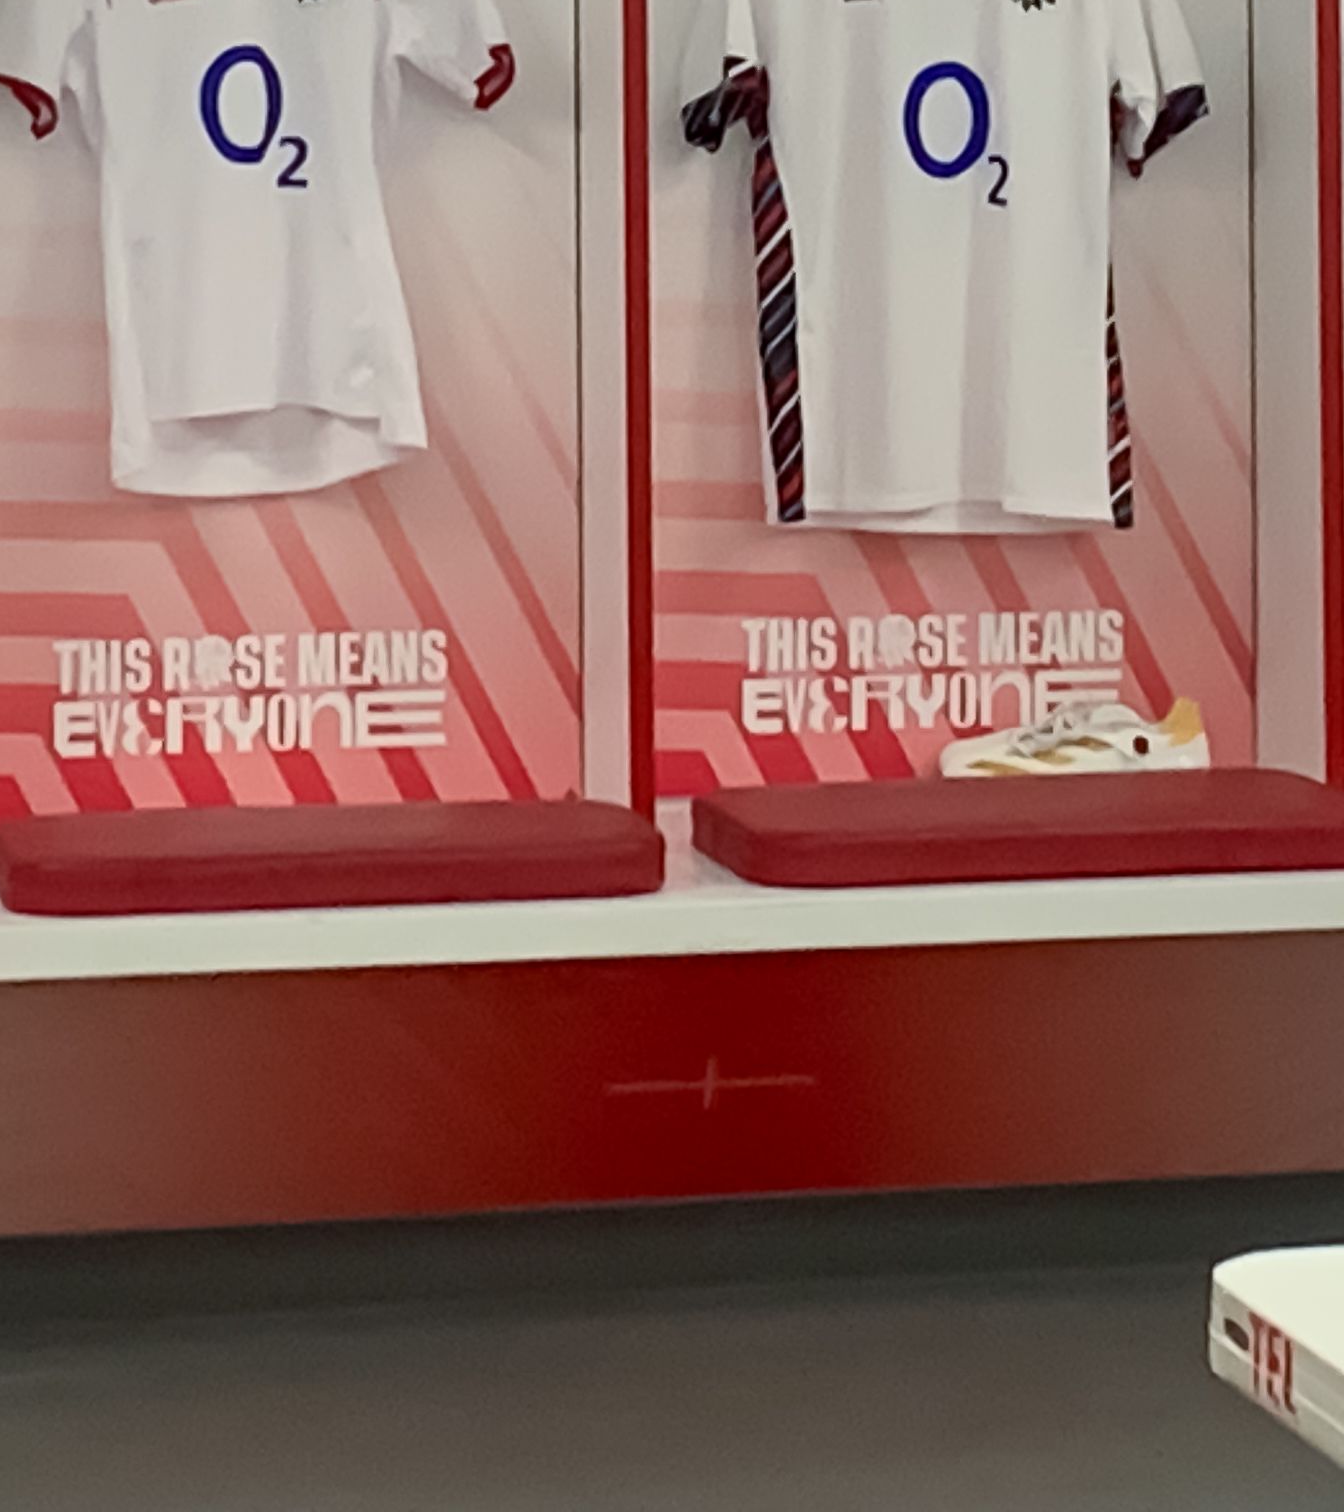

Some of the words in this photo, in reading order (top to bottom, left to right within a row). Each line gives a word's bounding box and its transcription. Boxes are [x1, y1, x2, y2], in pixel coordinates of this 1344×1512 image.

[199, 44, 309, 189] O2
[903, 60, 1009, 207] O2
[53, 638, 152, 694] THIS
[298, 629, 447, 686] MEANS
[741, 616, 836, 671] THIS
[978, 609, 1124, 664] MEANS
